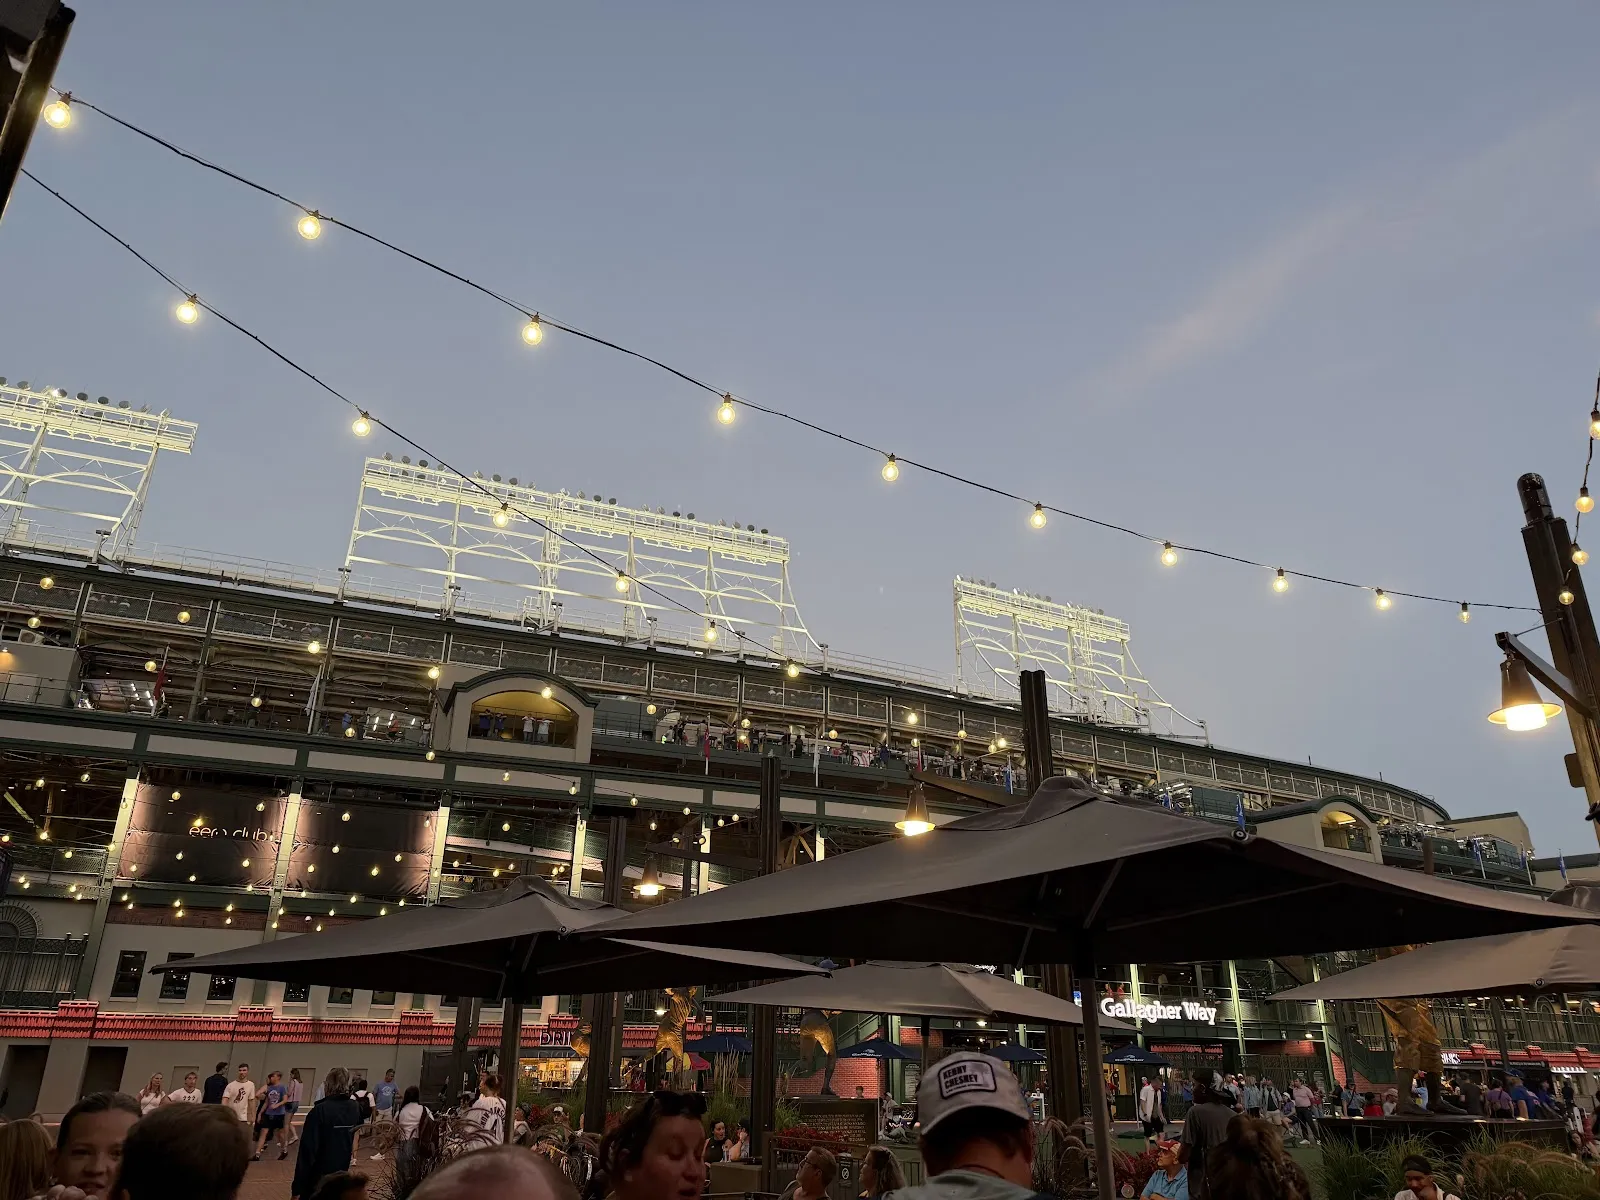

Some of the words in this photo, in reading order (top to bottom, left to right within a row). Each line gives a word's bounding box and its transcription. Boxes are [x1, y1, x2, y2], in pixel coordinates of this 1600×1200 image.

[1100, 997, 1182, 1024] Gallagher
[1182, 1001, 1217, 1026] Way
[943, 1065, 967, 1080] KENNY
[944, 1074, 978, 1090] CHESNEY
